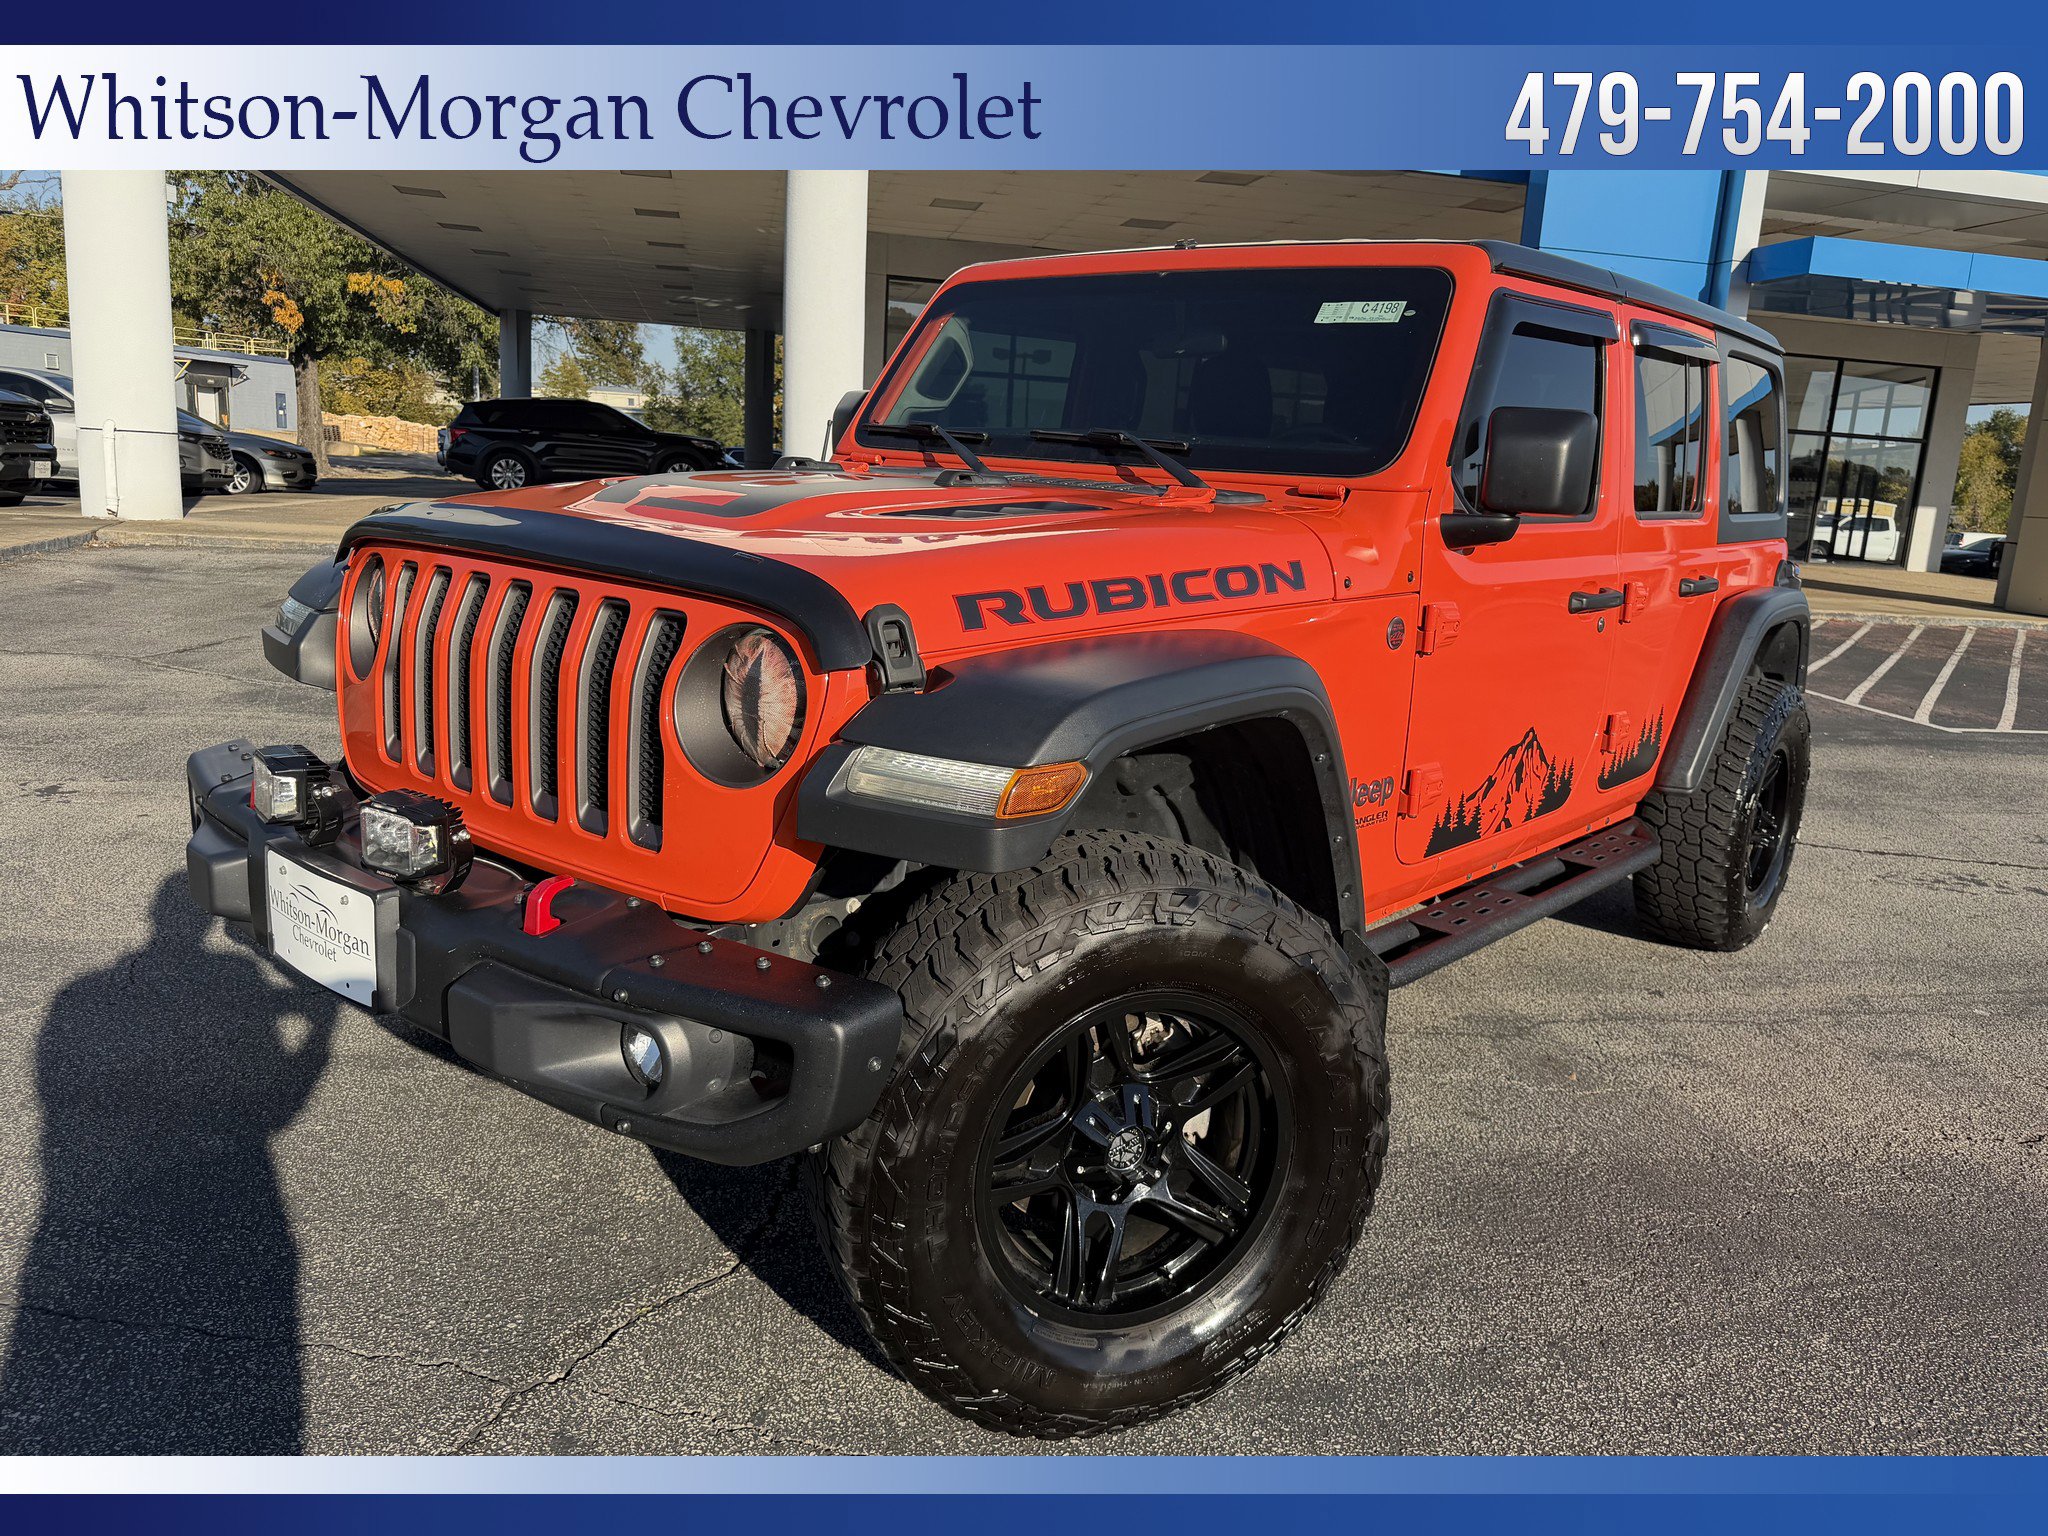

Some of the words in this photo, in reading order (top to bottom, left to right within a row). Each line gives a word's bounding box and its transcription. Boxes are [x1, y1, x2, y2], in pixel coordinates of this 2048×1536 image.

[953, 559, 1306, 632] RUBICON
[1355, 810, 1388, 825] ANGLER
[269, 885, 371, 957] Whitson-Morgan
[292, 924, 337, 963] Chevrolet
